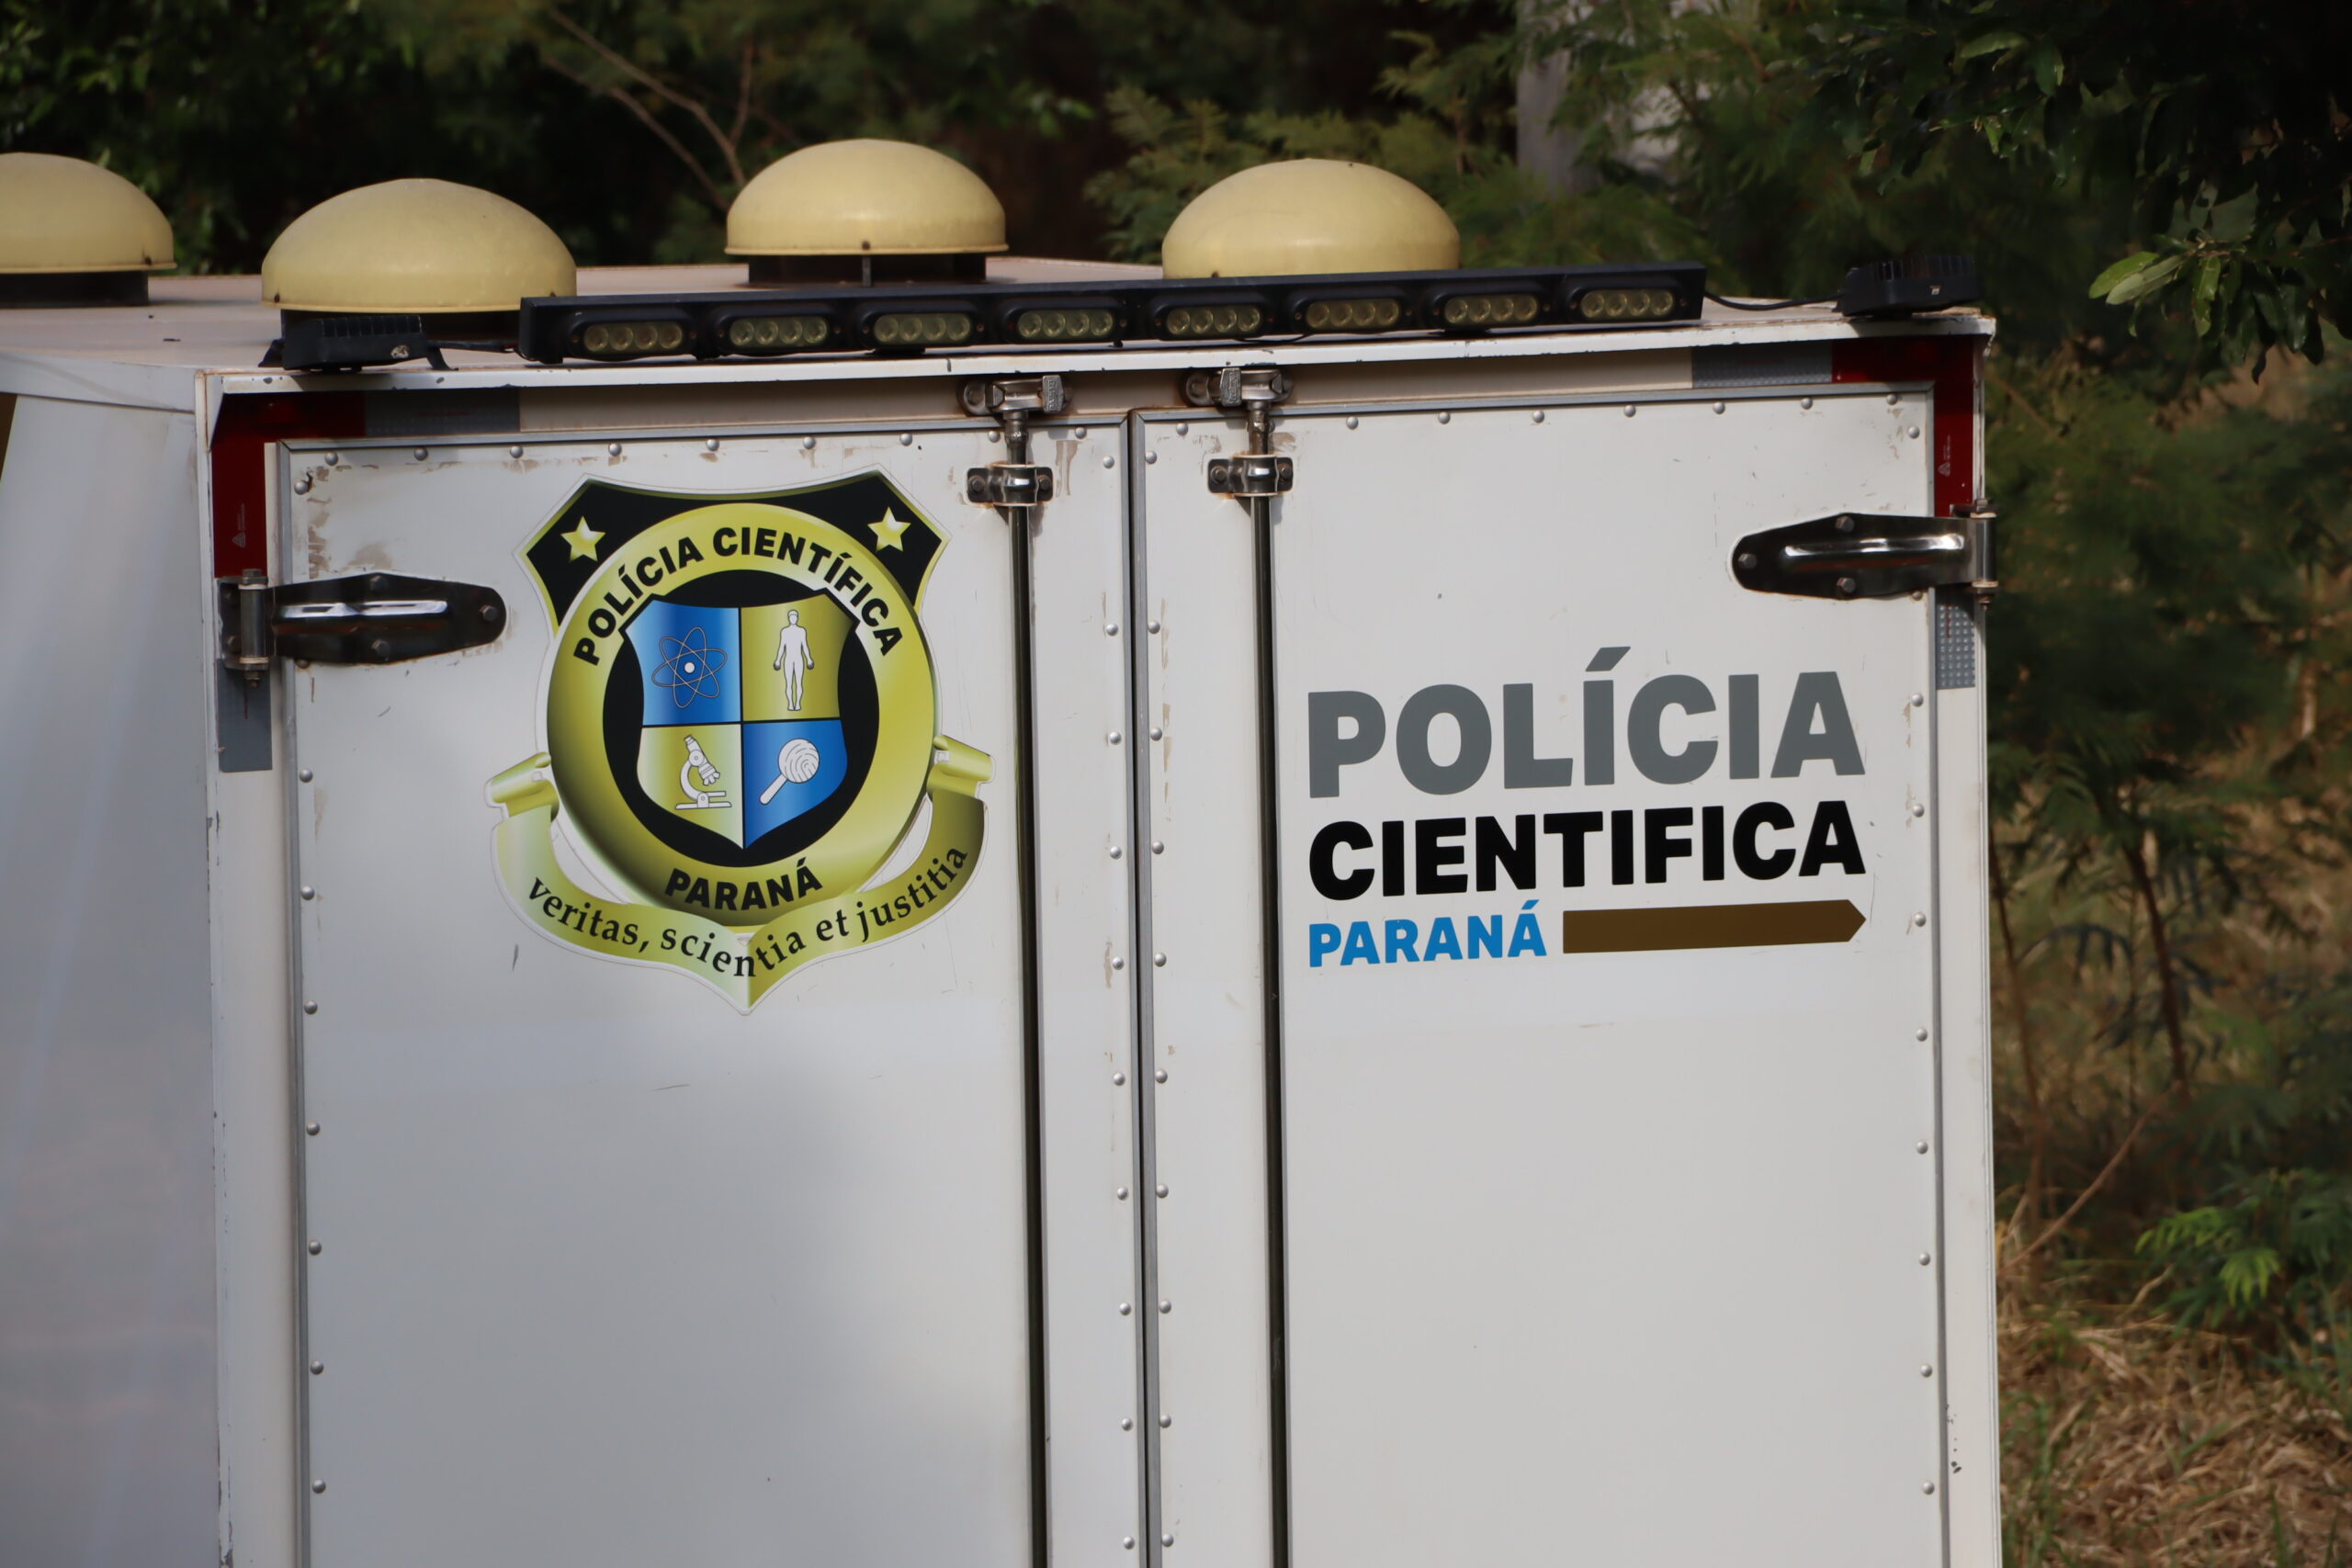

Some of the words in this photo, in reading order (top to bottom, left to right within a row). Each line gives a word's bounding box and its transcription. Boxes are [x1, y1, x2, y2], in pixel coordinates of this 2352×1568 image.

[573, 536, 705, 665] POLÍCIA
[713, 526, 903, 656] CIENTÍFICA
[1308, 646, 1866, 798] POLÍCIA
[665, 857, 823, 911] PARANÁ
[1309, 800, 1866, 901] CIENTIFICA
[528, 876, 650, 953] veritas,
[661, 928, 807, 977] scientia
[816, 908, 850, 942] et
[856, 847, 968, 942] justitia
[1309, 899, 1547, 967] PARANÁ
